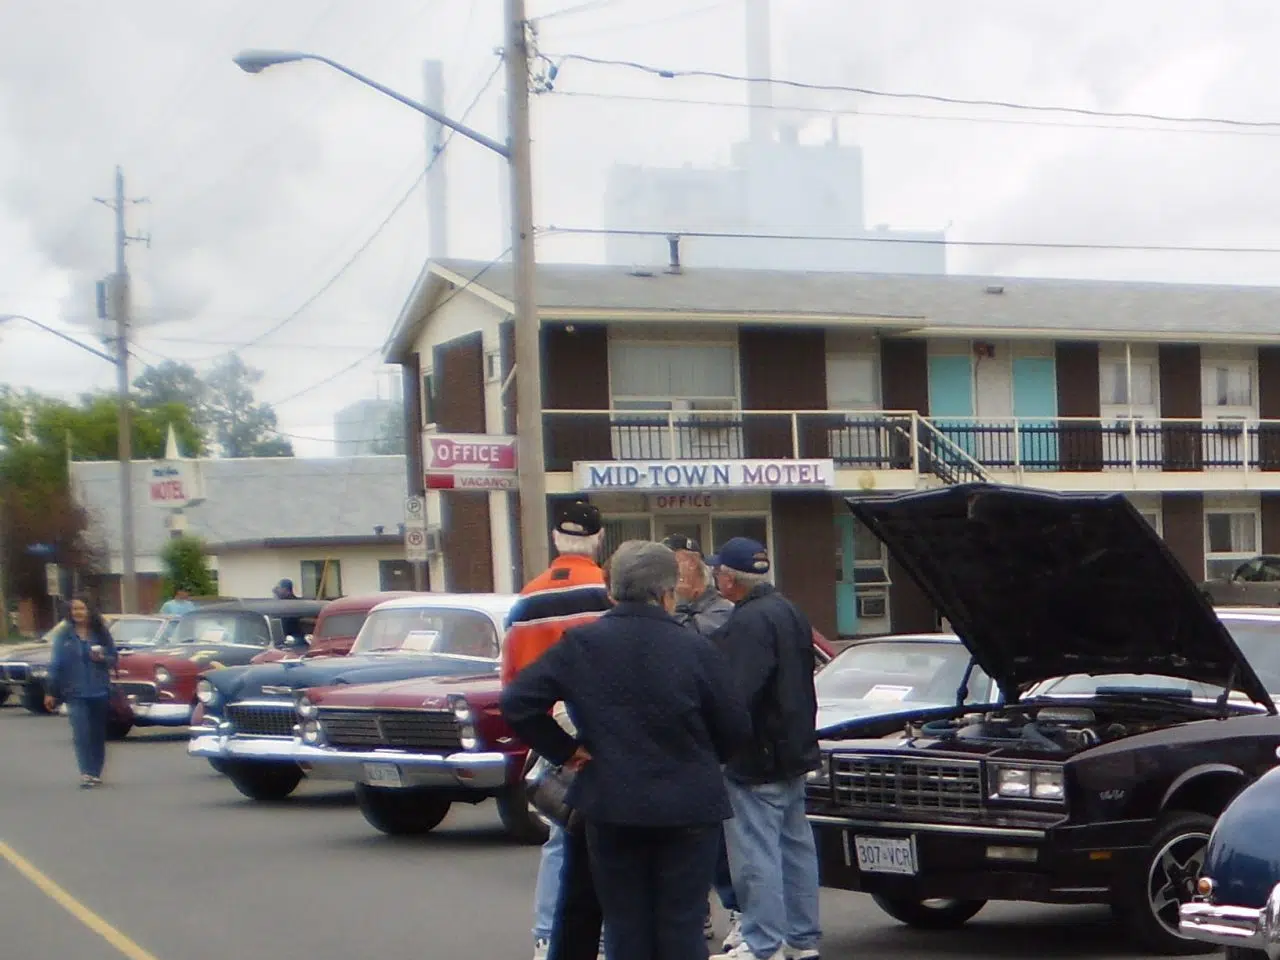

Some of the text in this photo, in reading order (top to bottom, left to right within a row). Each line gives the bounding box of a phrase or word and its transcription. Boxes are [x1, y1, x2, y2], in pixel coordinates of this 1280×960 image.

[437, 444, 500, 462] OFFICE
[589, 463, 826, 487] MID-TOWN MOTEL
[656, 494, 713, 509] OFFICE
[859, 845, 880, 864] 307
